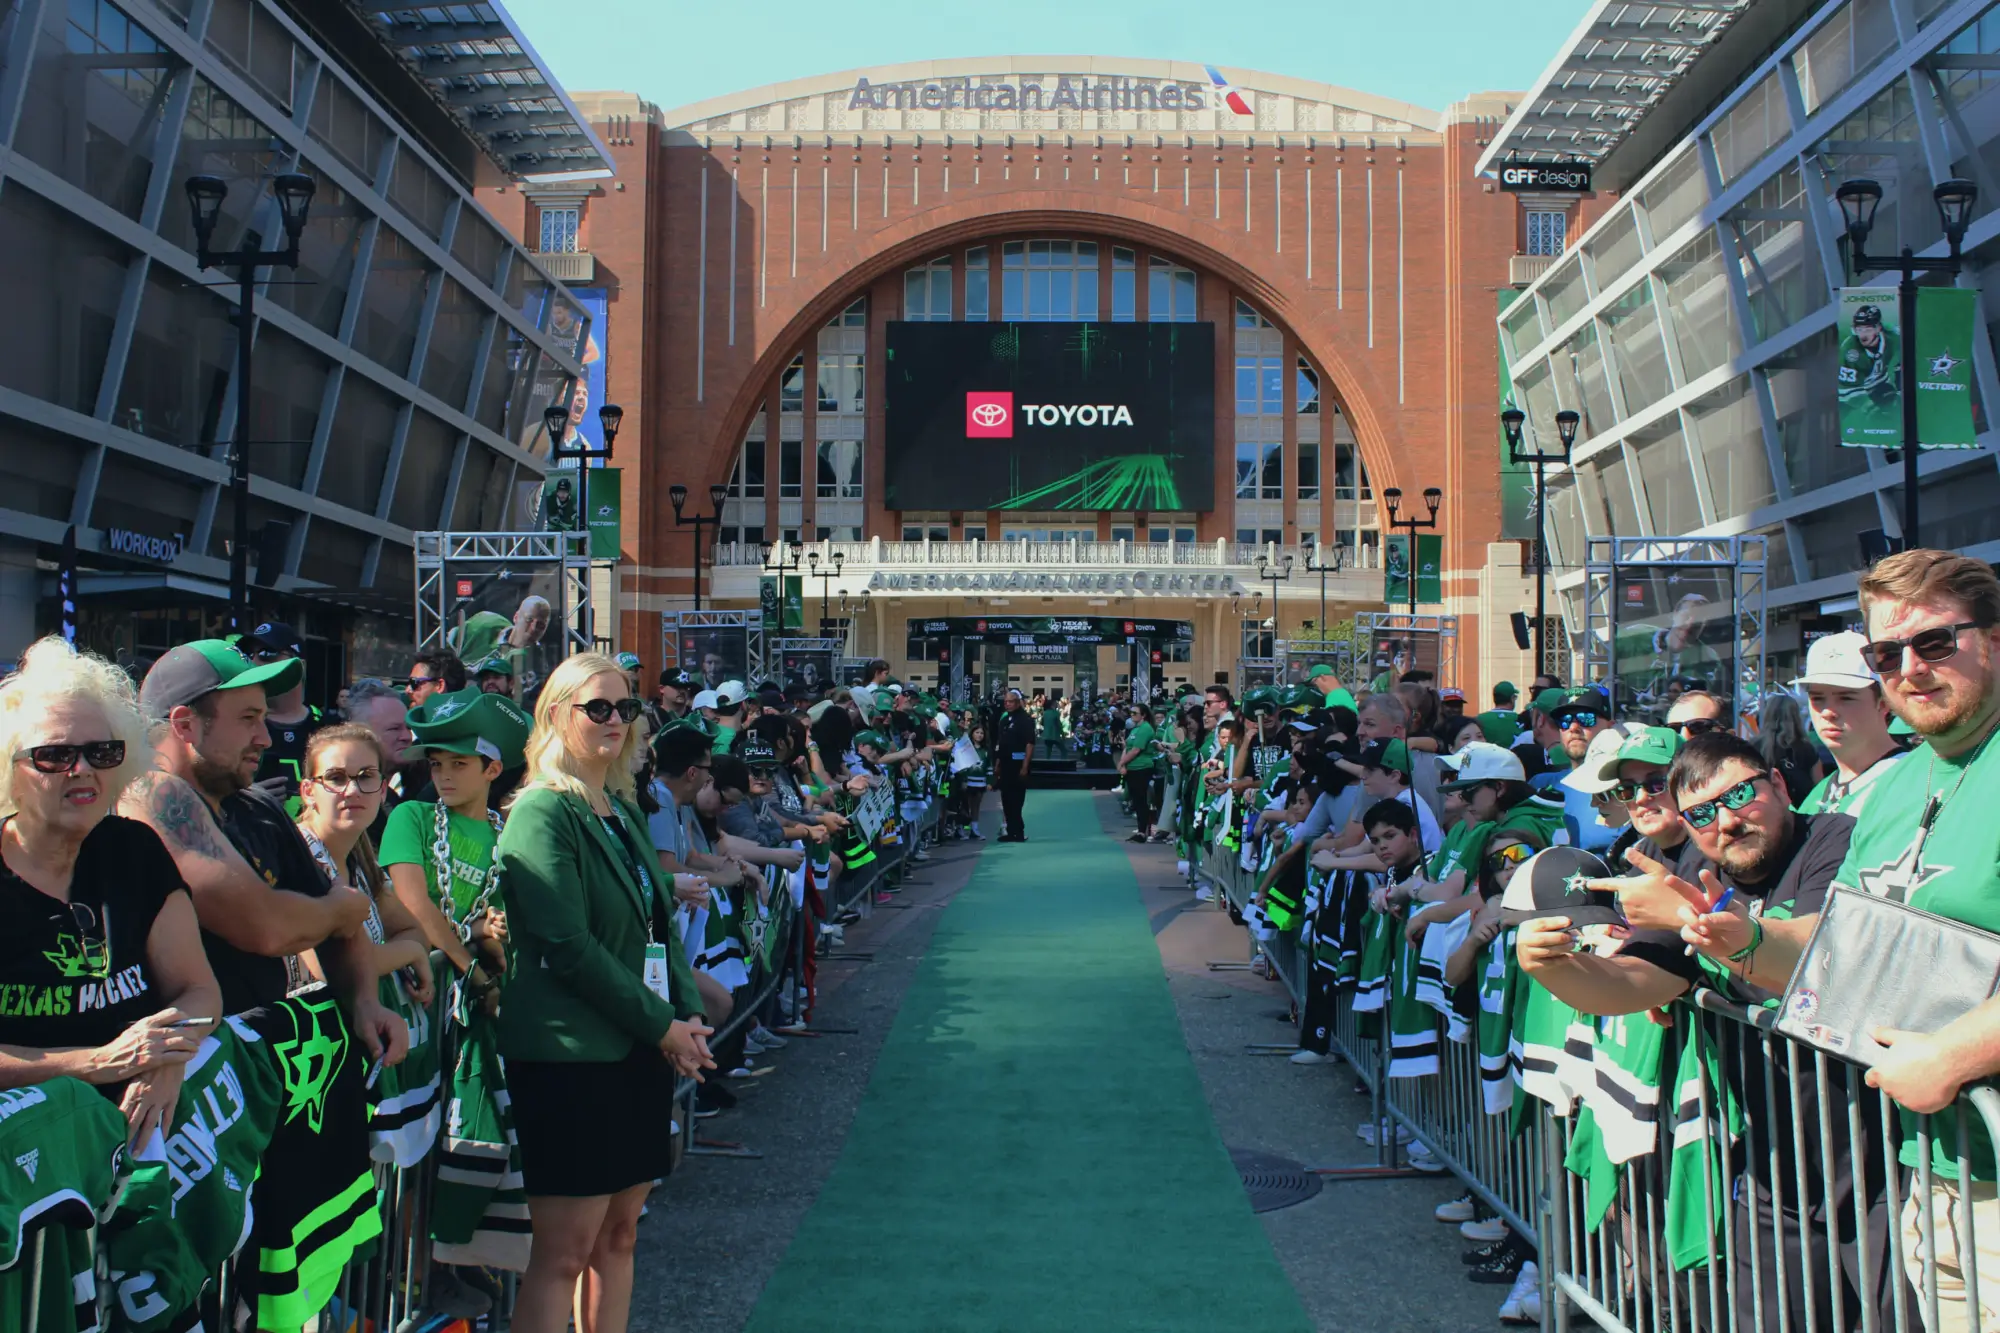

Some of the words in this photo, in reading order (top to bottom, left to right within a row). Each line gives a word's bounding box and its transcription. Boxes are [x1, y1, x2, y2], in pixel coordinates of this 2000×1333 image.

[848, 77, 1042, 111] American
[1049, 77, 1203, 111] Airlines
[1503, 168, 1538, 184] GFF
[1538, 169, 1588, 188] design
[1021, 404, 1134, 426] TOYOTA
[110, 527, 177, 561] WORKBOX
[867, 570, 1004, 591] AMERICAN
[1004, 570, 1128, 591] AIRLINES
[1132, 571, 1235, 592] CENTER
[452, 858, 486, 887] THE
